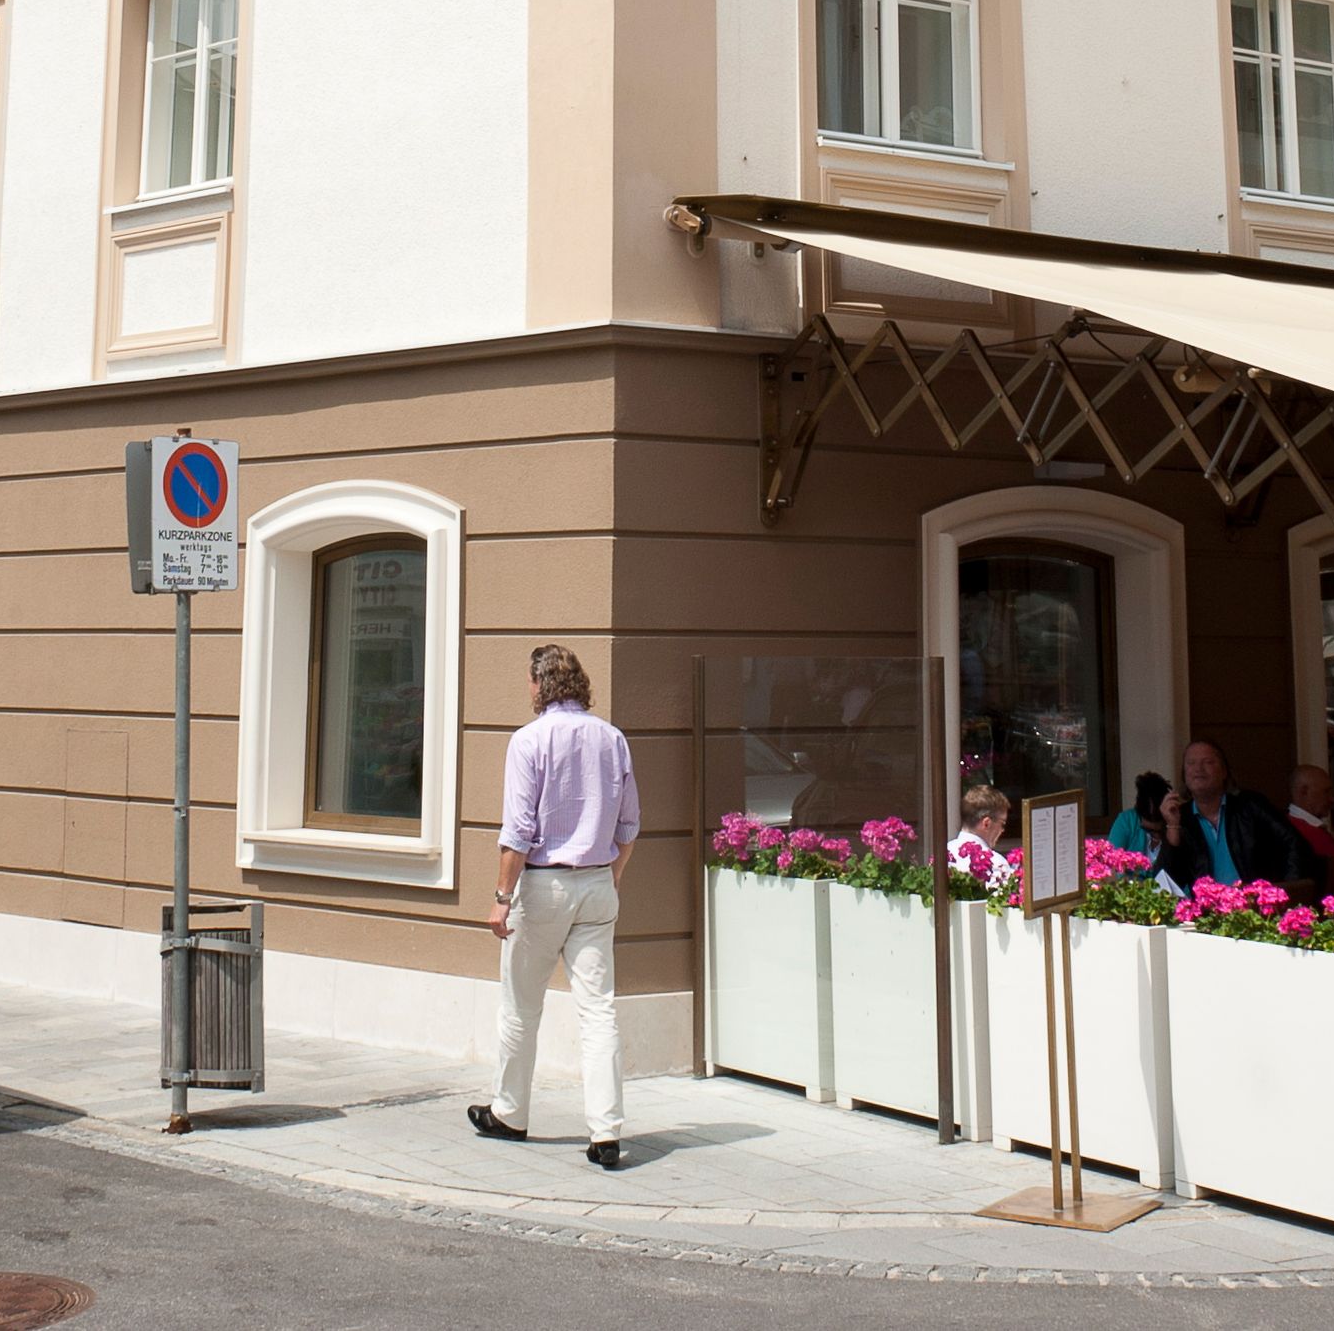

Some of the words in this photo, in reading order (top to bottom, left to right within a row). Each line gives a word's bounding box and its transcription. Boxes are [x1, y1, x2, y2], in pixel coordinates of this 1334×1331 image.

[158, 530, 233, 542] KURZPARKZONE
[180, 543, 212, 553] werktags
[163, 563, 192, 575] Samstag
[163, 575, 195, 585] Parkdauer
[197, 576, 206, 586] 90
